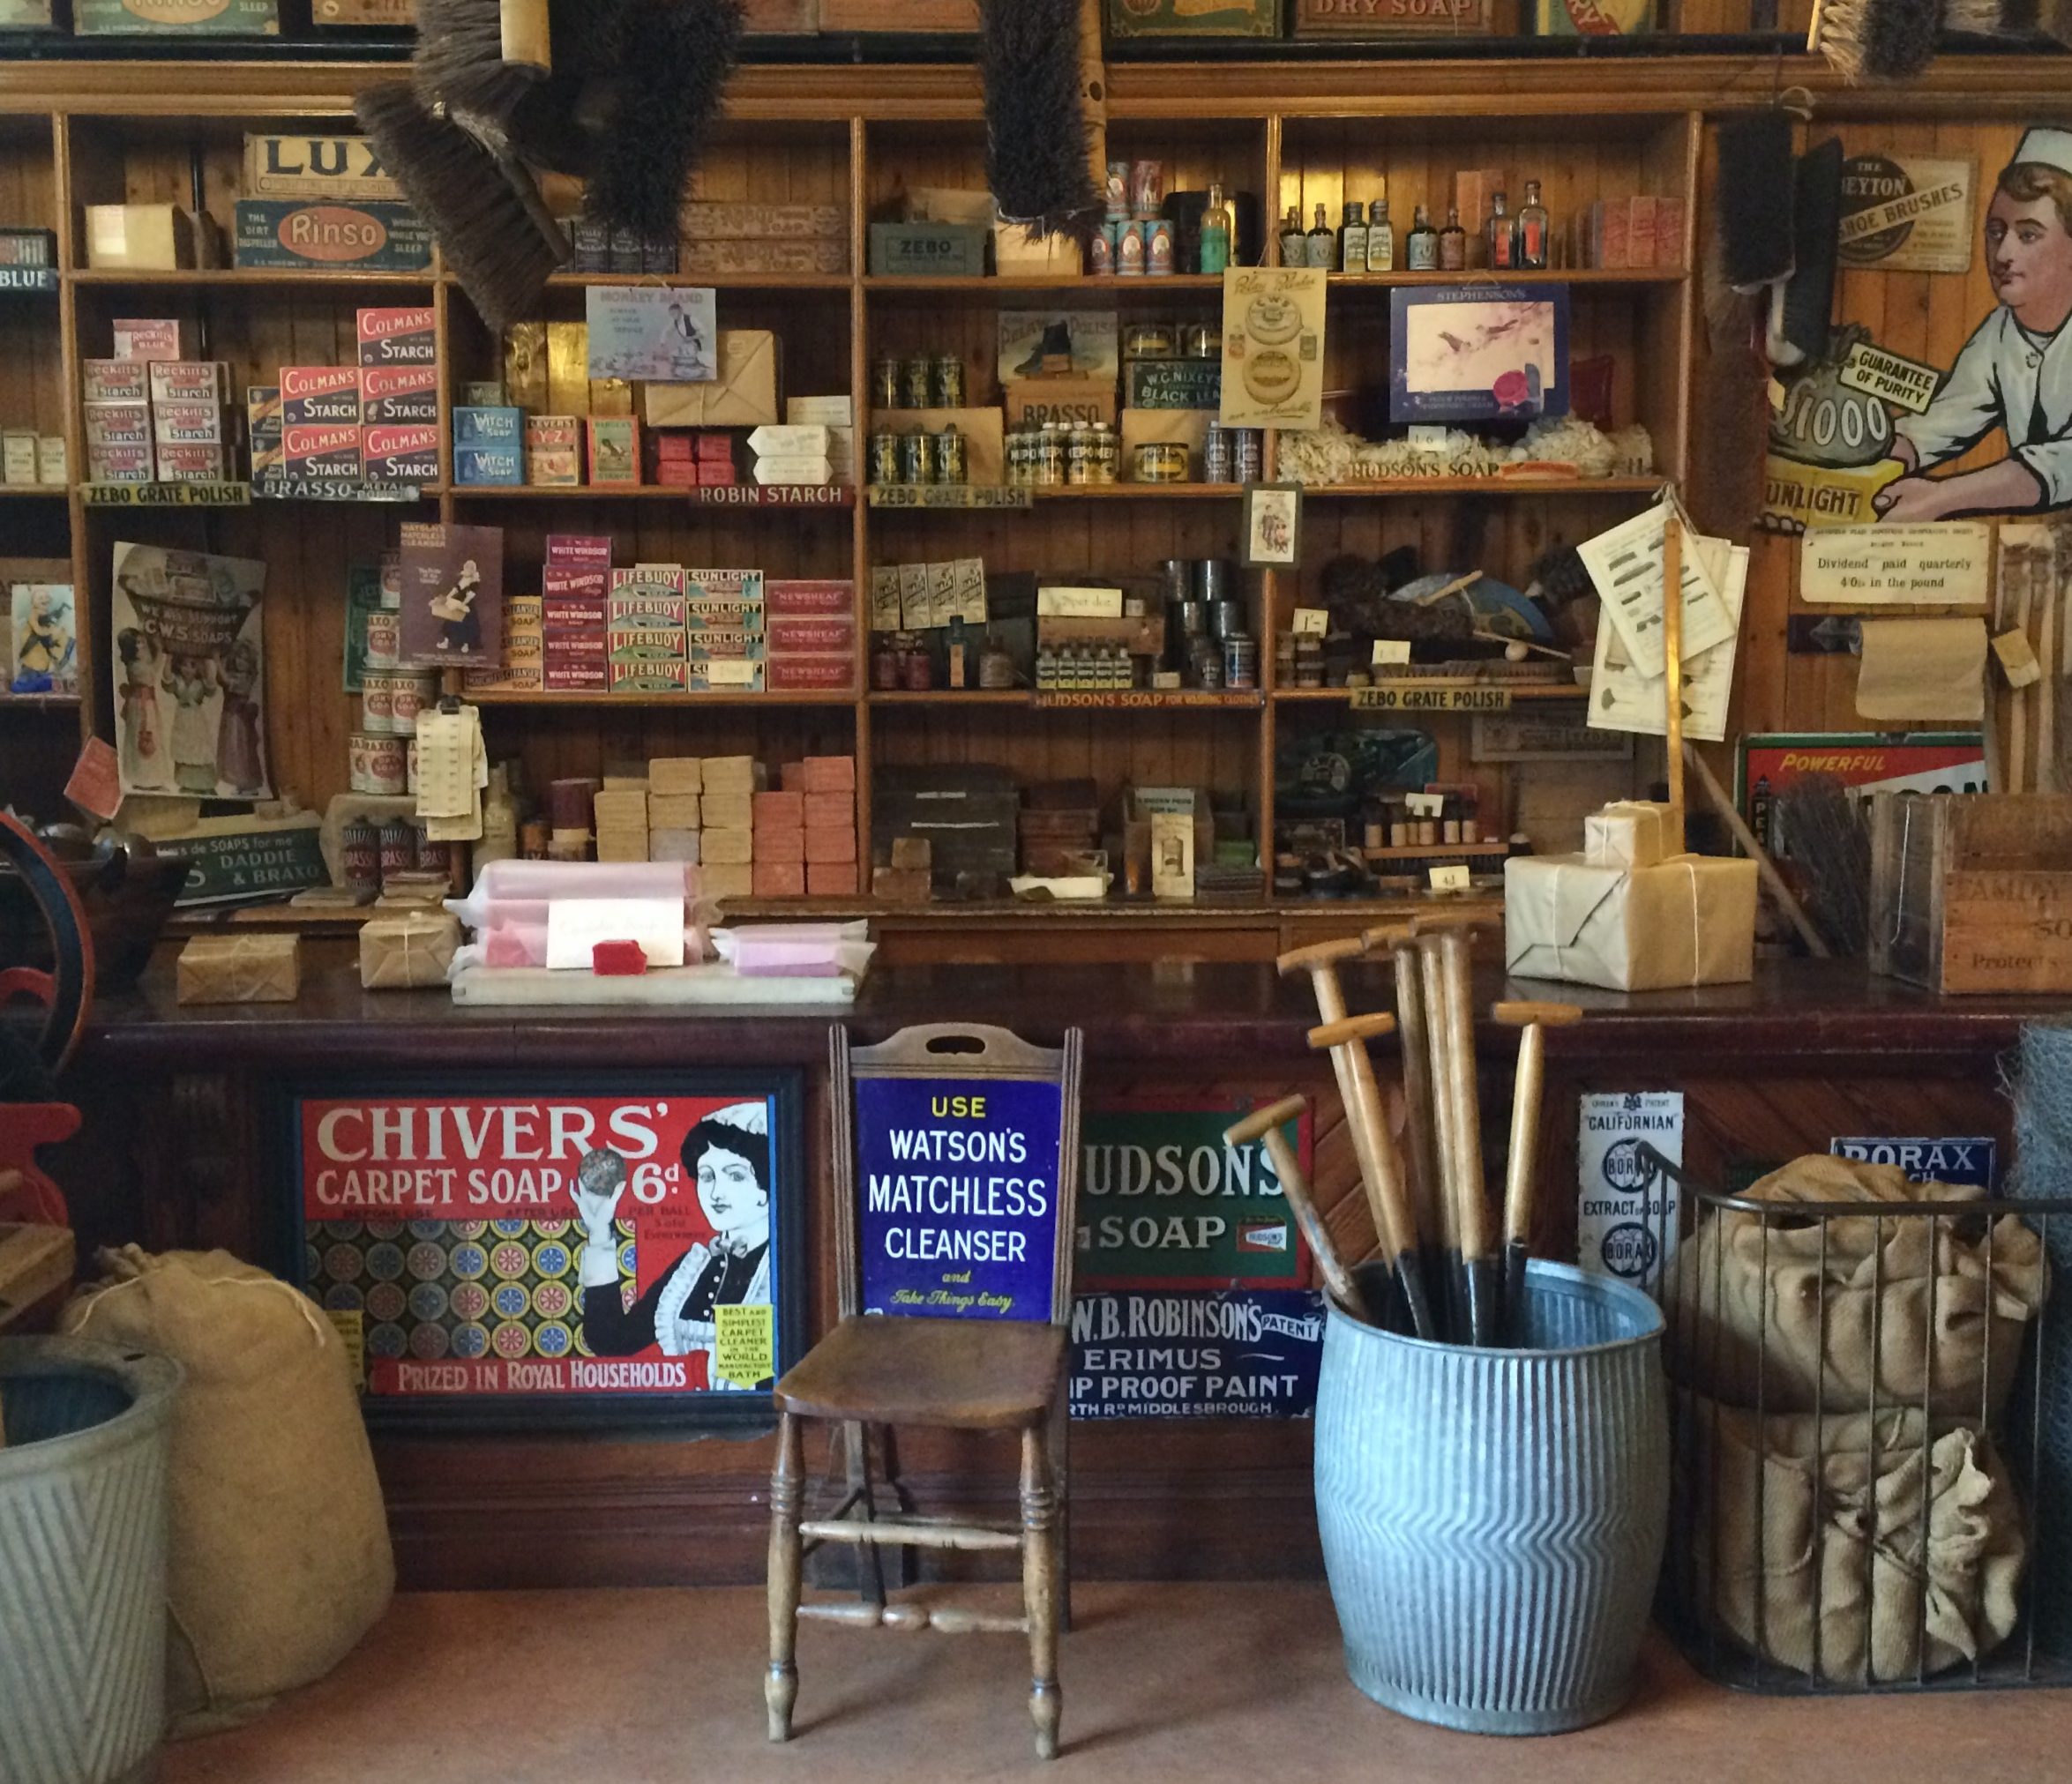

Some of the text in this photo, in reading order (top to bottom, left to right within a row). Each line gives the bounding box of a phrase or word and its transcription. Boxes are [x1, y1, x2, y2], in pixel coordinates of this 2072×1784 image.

[1313, 0, 1471, 16] DRY SOAP
[1858, 162, 1881, 171] THE
[1842, 176, 1906, 196] EYTON
[1884, 183, 1963, 222] BRUSHES
[247, 213, 266, 222] THE
[291, 214, 377, 246] Rinso
[394, 243, 423, 253] SLEEP
[901, 240, 951, 254] ZEBO
[380, 339, 434, 359] STARCH
[1859, 350, 1934, 392] GUARANTEE
[99, 386, 140, 397] Starch
[168, 387, 210, 398] Starch
[1141, 385, 1221, 403] BLACK LEA
[1856, 369, 1926, 404] OF PURITY
[303, 398, 357, 418] STARCH
[384, 398, 437, 418] STARCH
[1023, 405, 1100, 422] BRASSO
[473, 412, 513, 429] WITCH
[103, 431, 144, 441] Starch
[170, 429, 213, 439] Starch
[539, 429, 563, 443] Y Z
[305, 457, 358, 477] STARCH
[385, 457, 438, 477] STARCH
[474, 452, 514, 469] WITCH
[105, 470, 146, 481] Starch
[174, 469, 215, 481] Starch
[1351, 463, 1500, 478] HUDSON'S SOAP
[90, 487, 243, 504] ZEBO GRATE POLISH
[265, 481, 353, 498] BRASSO
[700, 486, 842, 504] ROBIN STARCH
[879, 489, 917, 504] ZEBO
[975, 489, 1026, 504] POLISH
[1766, 482, 1861, 516] UNLIGHT
[551, 546, 607, 556] WHITE WINDSOR
[1817, 557, 1972, 572] Dividend paid quarterly
[546, 573, 604, 591] WHITE WINDSOR
[612, 571, 679, 587] LIFEBUOY
[691, 571, 758, 582] SUNLIGHT
[1870, 577, 1945, 592] in the pound
[613, 601, 680, 618] LIFEBUOY
[692, 602, 759, 614] SUNLIGHT
[193, 631, 233, 643] SOAPS
[613, 632, 680, 650] LIFEBUOY
[694, 634, 760, 645] SUNLIGHT
[571, 671, 604, 680] WINDSOR
[614, 663, 682, 681] LIFEBUOY
[1121, 694, 1163, 708] SOAP
[1165, 696, 1183, 705] FOR
[1358, 691, 1504, 706] ZEBO GRATE POLISH
[1779, 752, 1887, 773] POWERFUL
[191, 842, 206, 855] de
[210, 838, 250, 853] SOAPS
[253, 837, 269, 848] for
[274, 837, 293, 847] me
[221, 849, 297, 869] DADDIE
[233, 866, 319, 885] & BRAXO
[1972, 954, 2057, 969] Protects
[931, 1096, 986, 1118] USE
[316, 1102, 669, 1163] CHIVERS'
[889, 1127, 1027, 1163] WATSON'S
[1086, 1145, 1285, 1197] UDSONS
[316, 1168, 562, 1206] CARPET SOAP
[868, 1174, 1048, 1218] MATCHLESS
[505, 1208, 545, 1217] AFTER
[629, 1206, 691, 1215] PER BALL
[1583, 1200, 1676, 1216] EXTRACT SOP
[1099, 1216, 1226, 1250] SOAP
[886, 1227, 1027, 1262] CLEANSER
[942, 1270, 971, 1284] and
[889, 1289, 1012, 1314] Take Things Easy
[722, 1318, 766, 1327] SIMPLEST
[1262, 1316, 1313, 1339] PATENT
[722, 1353, 767, 1362] WORLD
[1083, 1348, 1222, 1371] ERIMUS
[397, 1360, 686, 1392] PRIZED IN ROYAL HOUSEHOLDS
[1070, 1375, 1299, 1399] P PROOF PAINT
